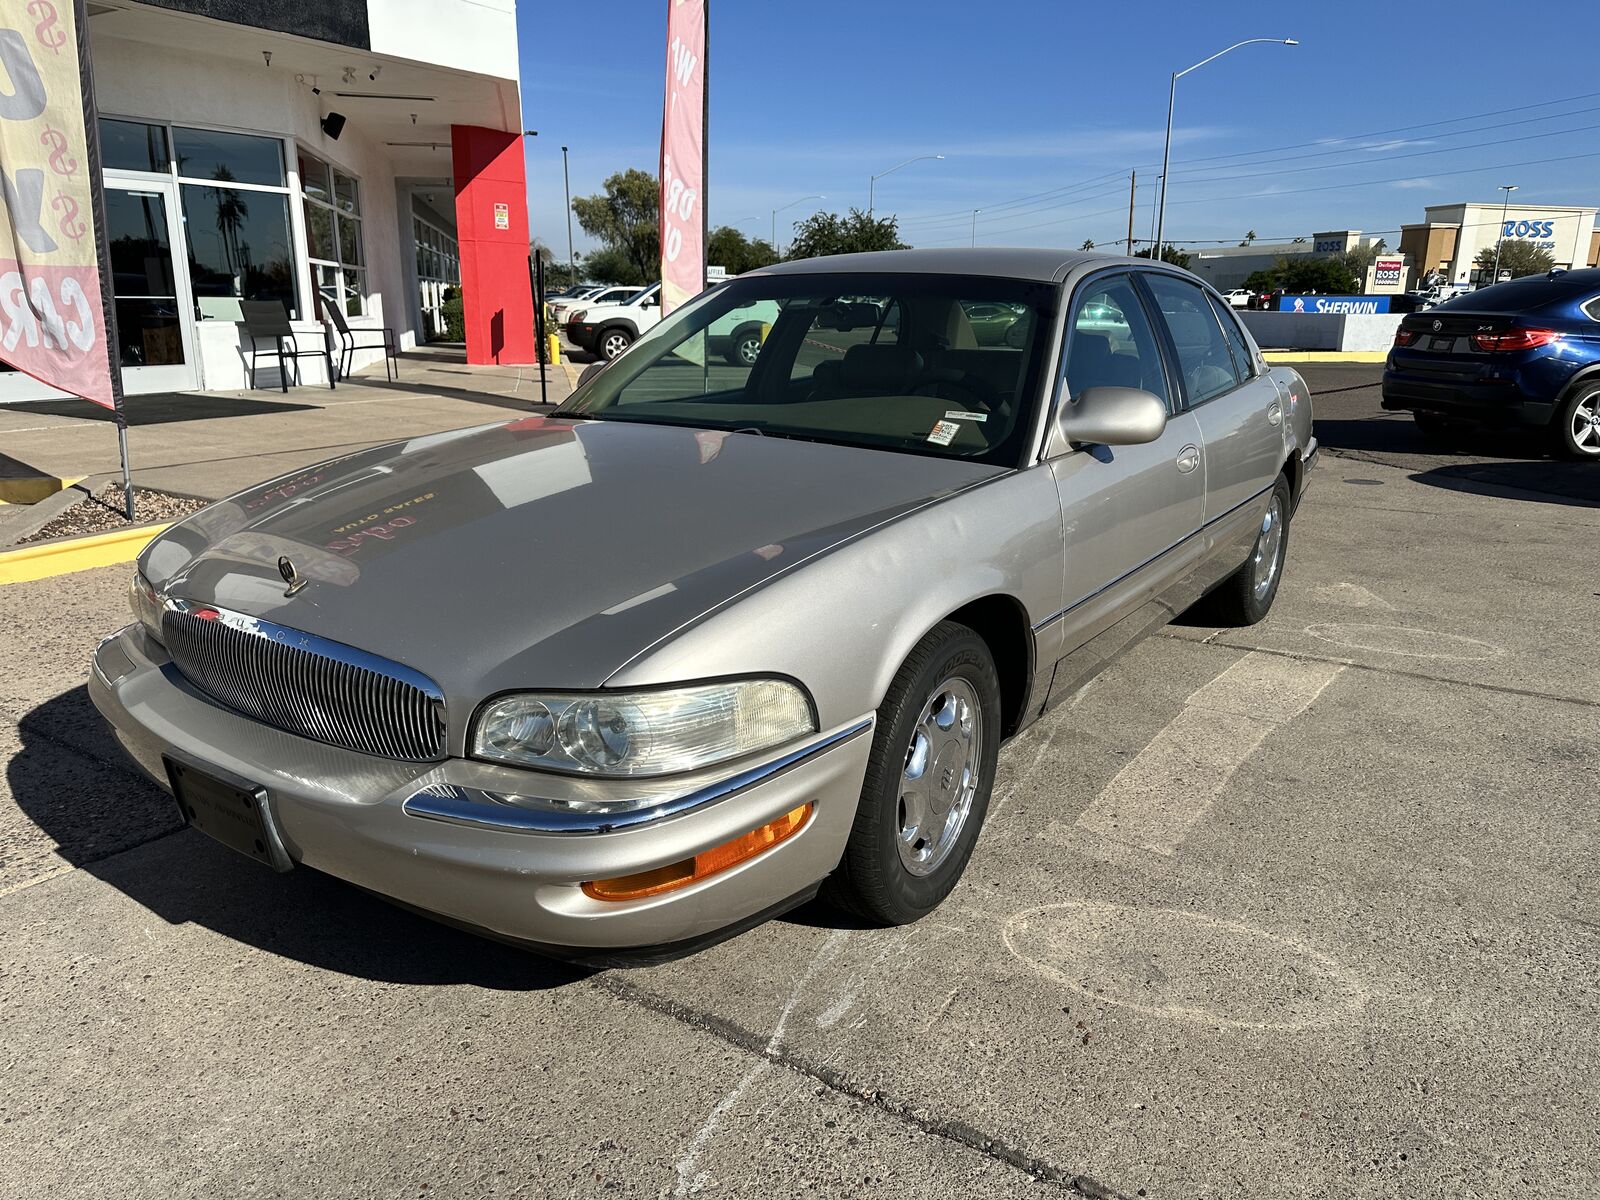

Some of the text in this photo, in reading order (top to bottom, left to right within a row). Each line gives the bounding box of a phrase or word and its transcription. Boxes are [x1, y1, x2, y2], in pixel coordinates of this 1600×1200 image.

[1502, 220, 1554, 238] ROSS
[1316, 240, 1341, 252] ROSS
[1376, 270, 1400, 279] ROSS
[1315, 299, 1378, 314] SHERWIN
